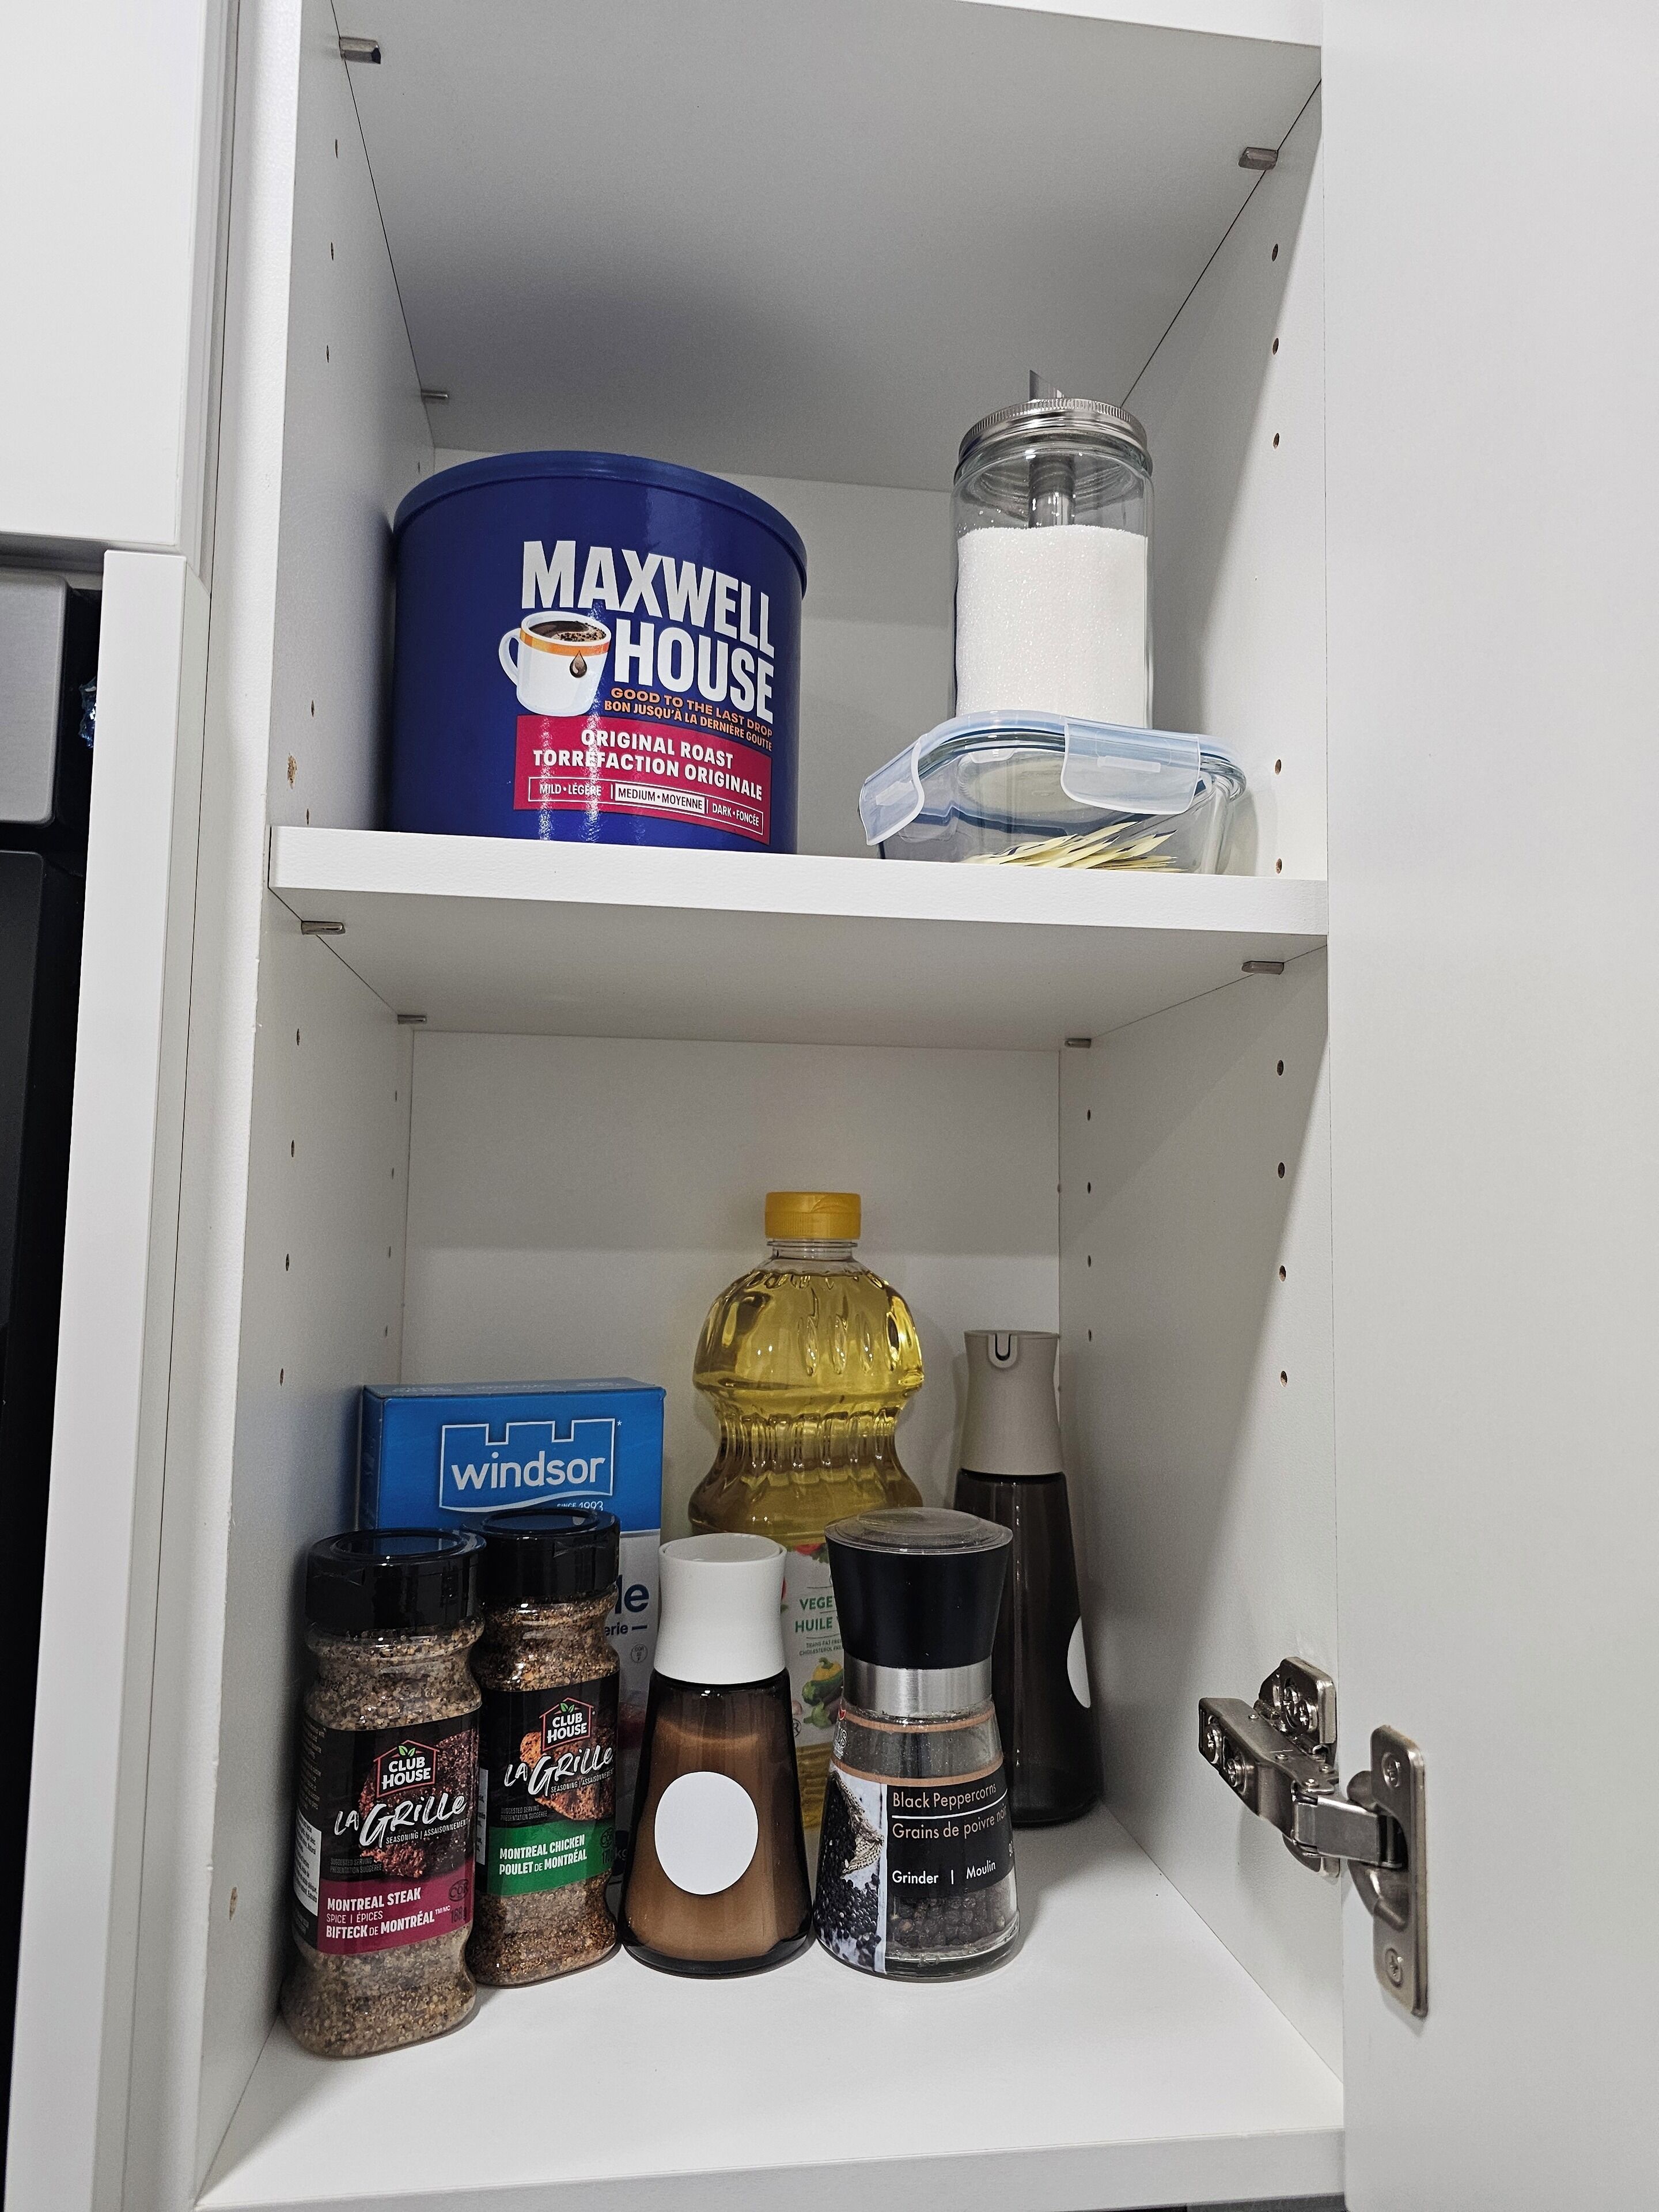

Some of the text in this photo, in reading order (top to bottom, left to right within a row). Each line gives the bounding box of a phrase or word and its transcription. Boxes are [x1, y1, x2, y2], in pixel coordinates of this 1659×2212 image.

[521, 540, 774, 658] MAXWELL
[614, 618, 774, 724] HOUSE
[611, 688, 772, 738] GOOD TO THE LAST DROP
[604, 700, 630, 713] BON
[685, 713, 698, 725] LA
[700, 716, 745, 739] DERNIÈRE
[746, 732, 772, 752] GOUTTE
[581, 729, 733, 770] ORIGINAL ROAST
[684, 764, 762, 801] ORIGINALE
[451, 1450, 605, 1490] windsor
[800, 1596, 833, 1611] VEGE
[795, 1617, 833, 1633] HUILE
[552, 1712, 582, 1728] CLUB
[547, 1722, 587, 1744] HOUSE
[389, 1756, 425, 1772] CLUB
[504, 1763, 528, 1787] LA
[381, 1767, 431, 1790] HOUSE
[551, 1780, 578, 1793] SEASONING
[893, 1783, 997, 1810] Black Peppercorns
[334, 1810, 359, 1836] LA
[386, 1818, 469, 1844] SEASONING ASSAISONNEMENT
[892, 1823, 940, 1839] Grains
[943, 1821, 959, 1838] de
[964, 1816, 995, 1839] poivre
[500, 1834, 585, 1859] MONTREAL CHICKEN
[499, 1861, 533, 1875] POULET
[534, 1862, 543, 1872] DE
[544, 1849, 587, 1870] MONTRÉAL
[892, 1860, 996, 1884] Grinder Moulin
[327, 1887, 422, 1911] MONTREAL STEAK
[326, 1925, 368, 1939] BIFTECK
[369, 1926, 378, 1936] DE
[381, 1910, 435, 1934] MONTRÉAL
[327, 1910, 383, 1923] SPICE ÉPICES
